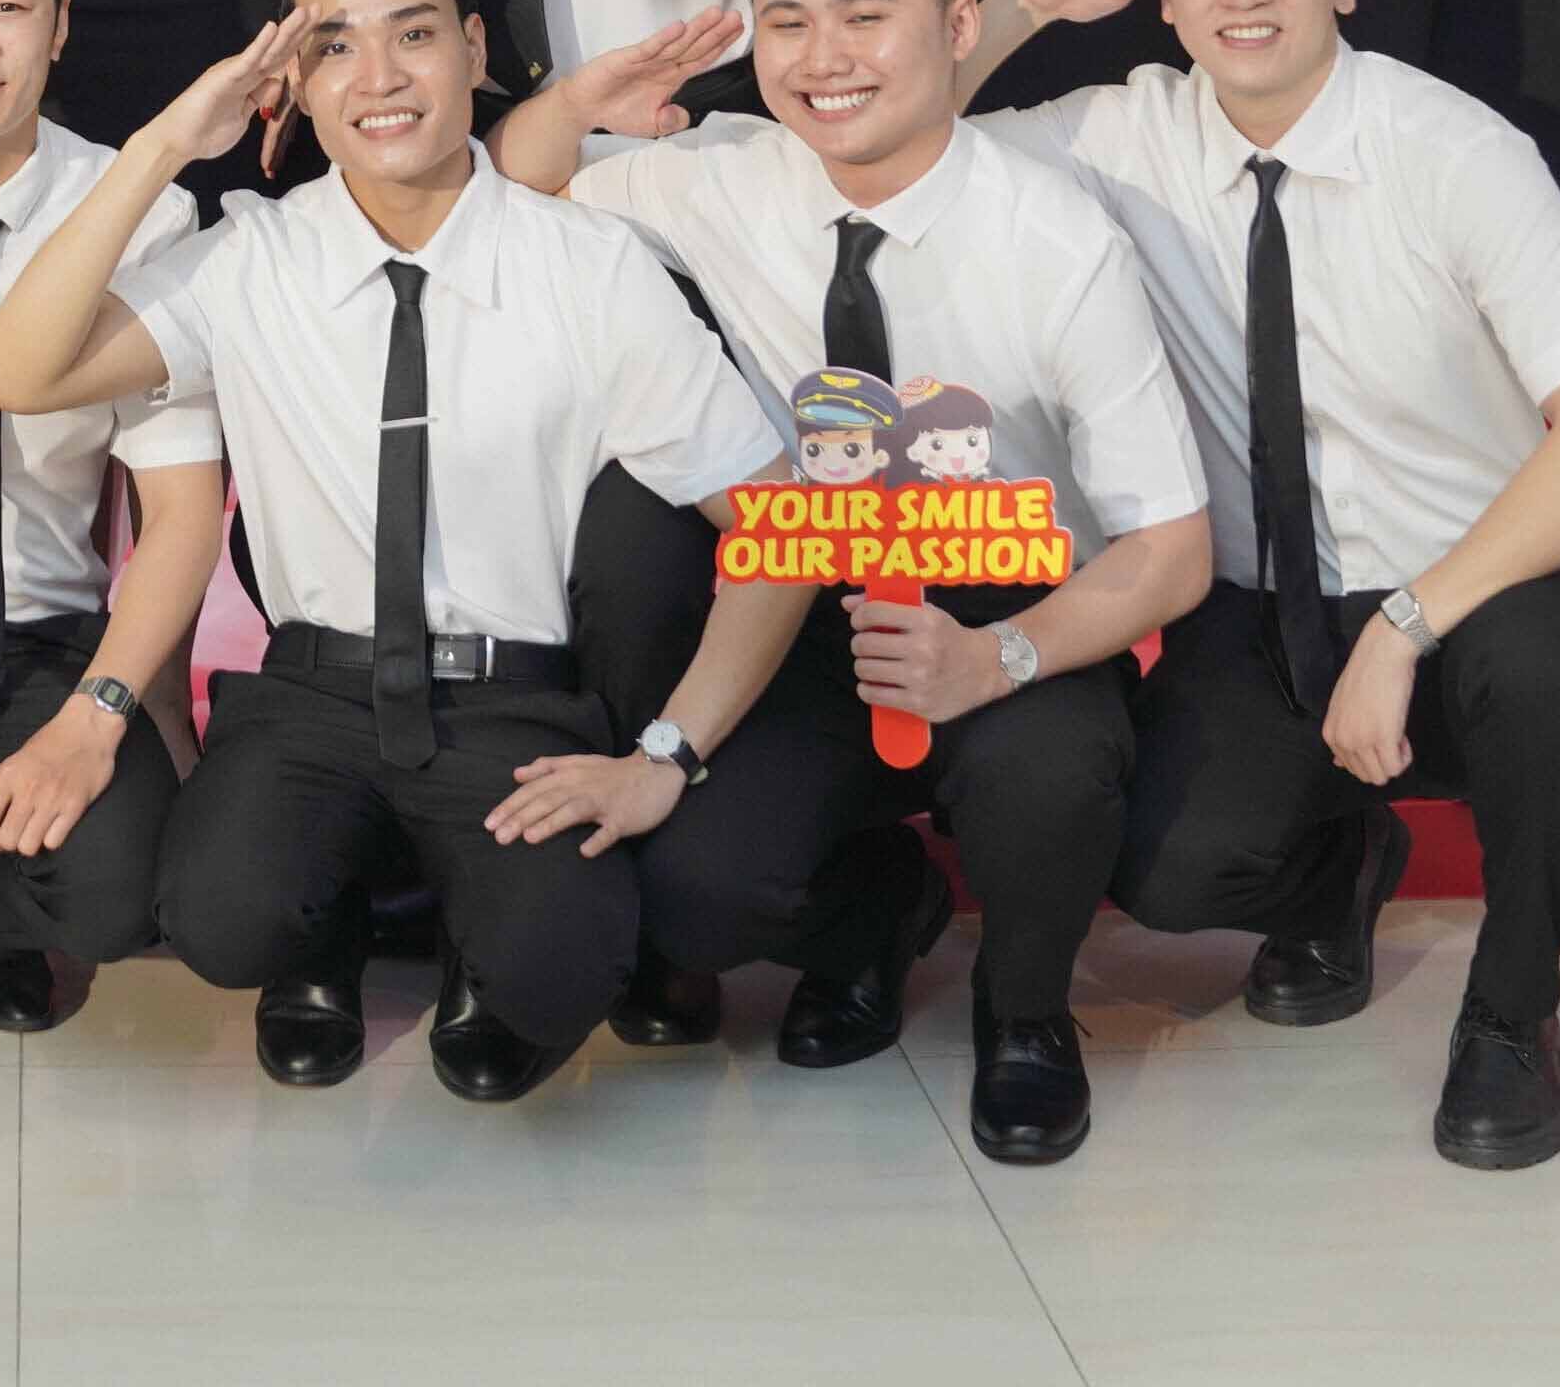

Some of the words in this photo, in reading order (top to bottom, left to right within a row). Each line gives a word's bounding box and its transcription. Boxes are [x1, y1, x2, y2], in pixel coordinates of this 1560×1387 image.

[735, 489, 882, 531] YOUR
[897, 488, 1048, 531] SMILE
[723, 537, 838, 578] OUR
[850, 536, 1067, 578] PASSION
